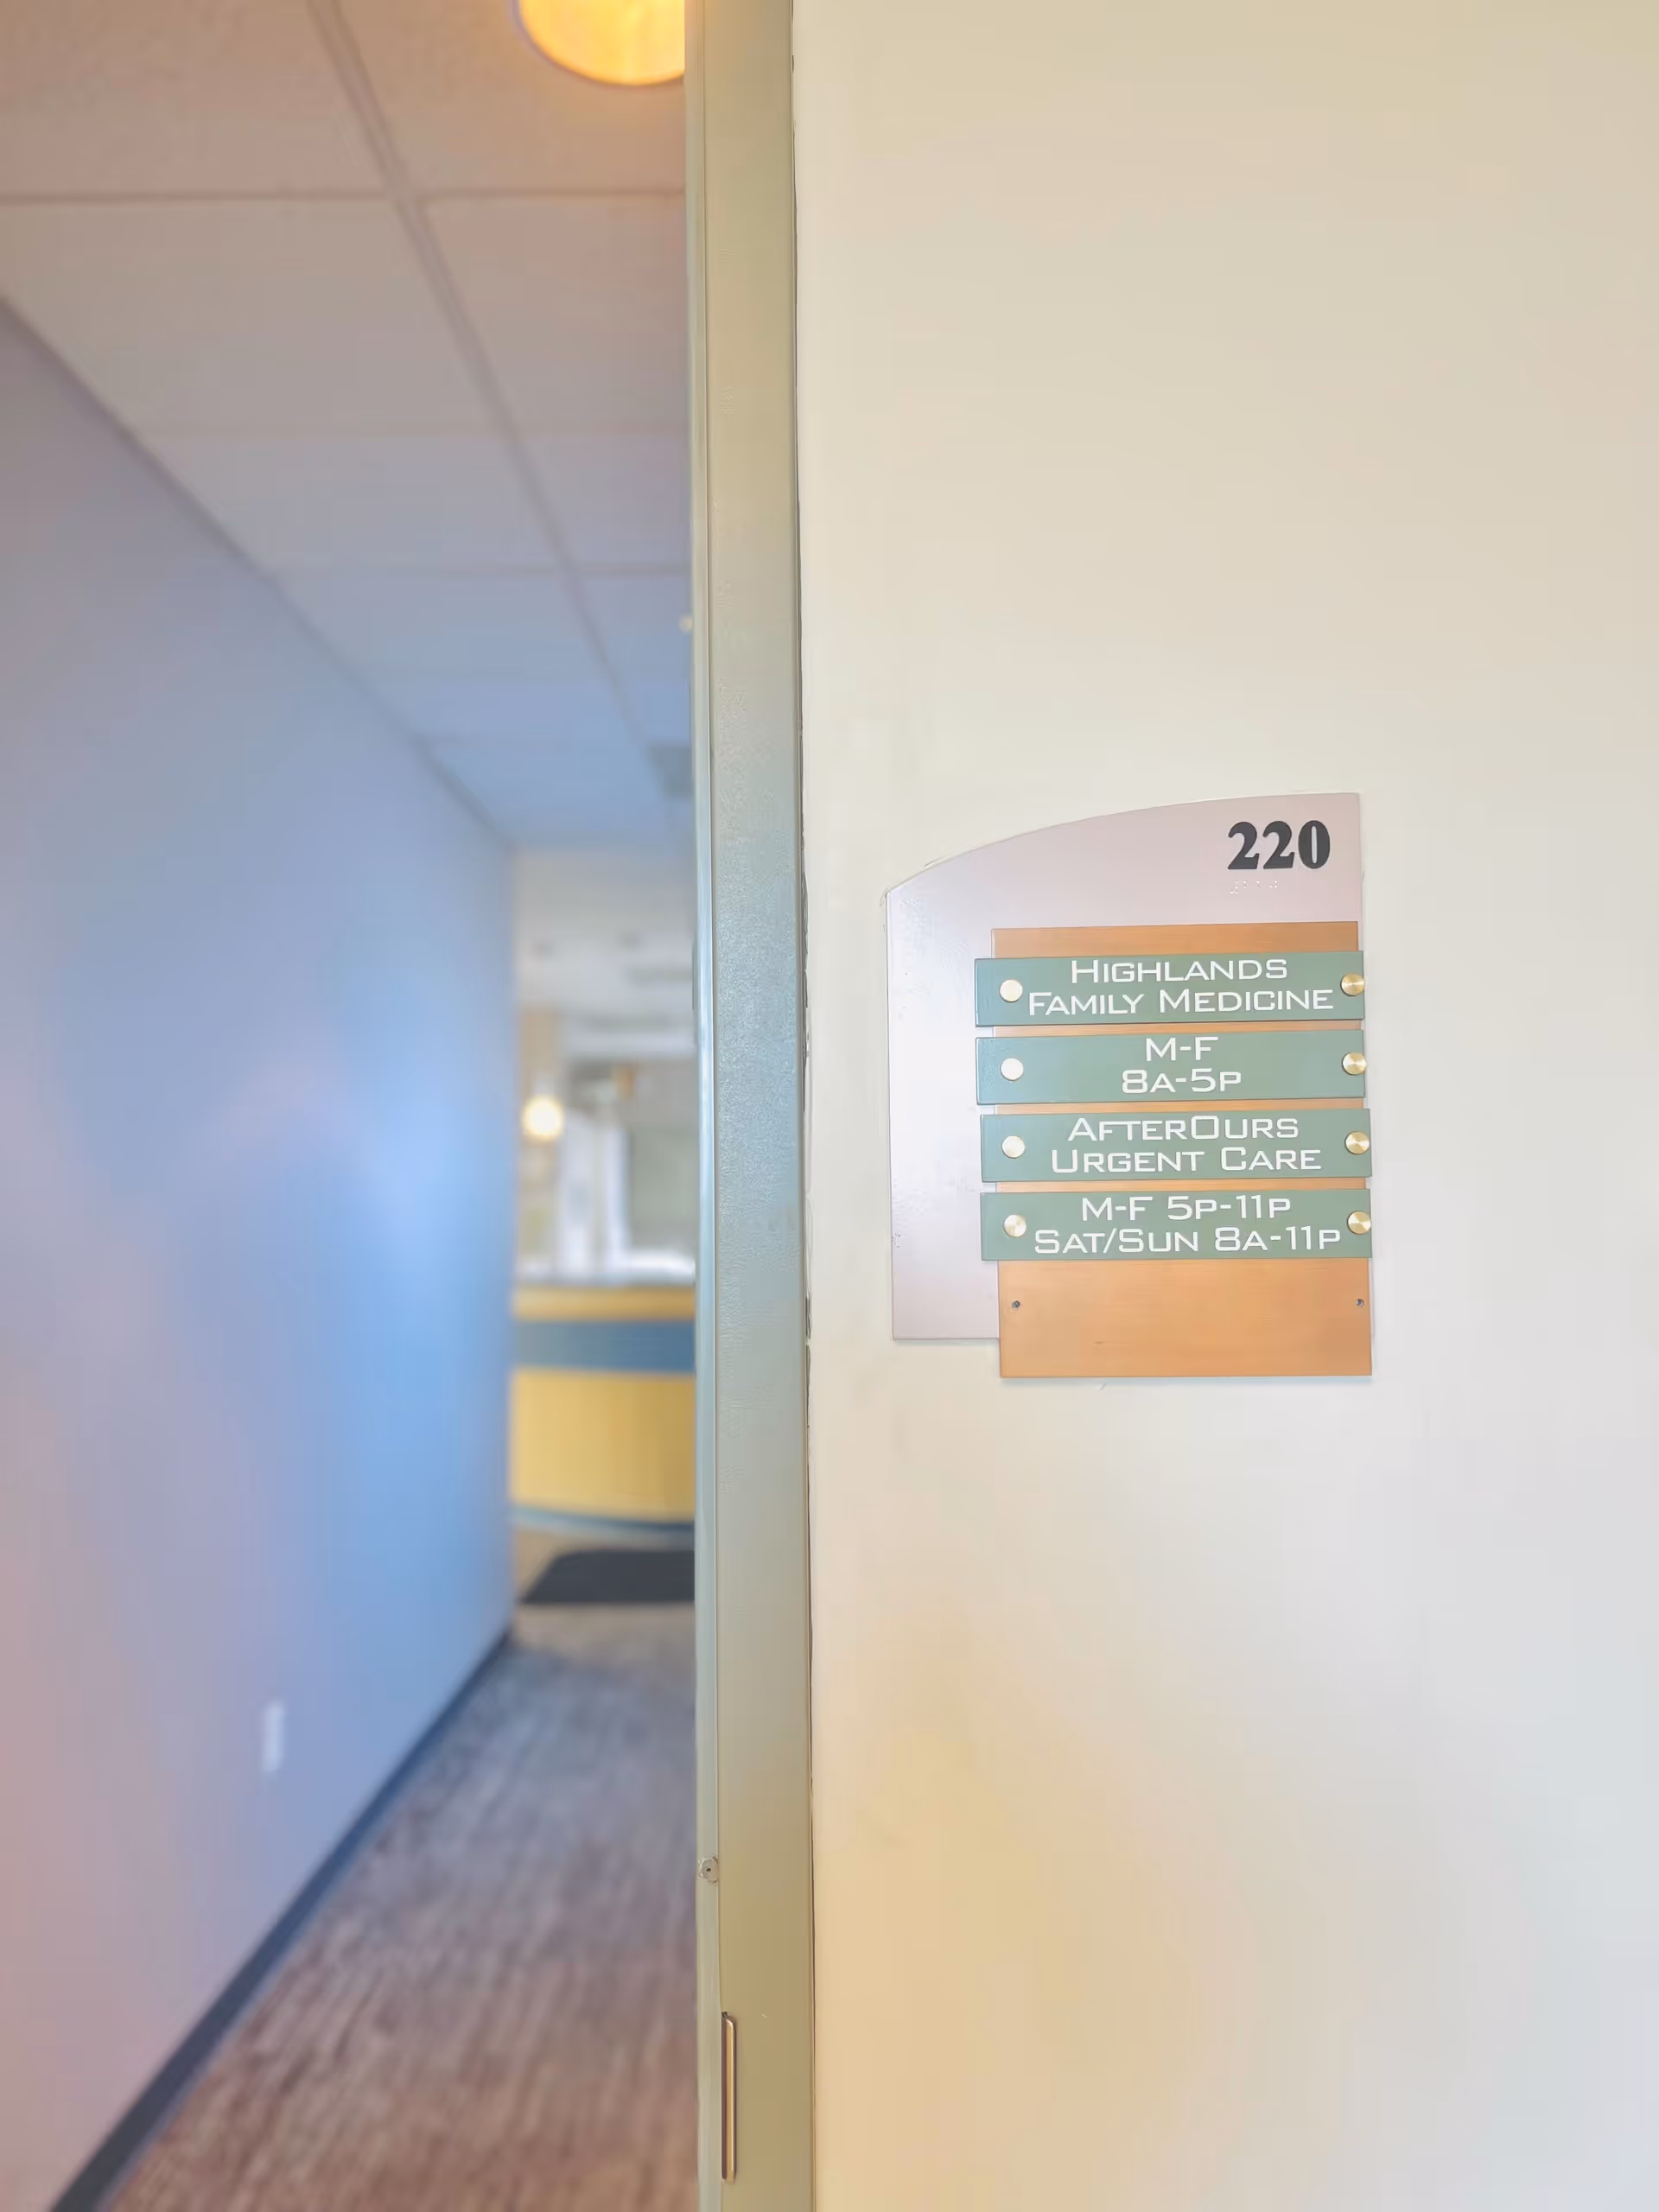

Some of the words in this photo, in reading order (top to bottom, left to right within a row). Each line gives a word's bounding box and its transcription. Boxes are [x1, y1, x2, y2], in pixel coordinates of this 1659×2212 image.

[1227, 820, 1331, 870] 220
[1071, 958, 1287, 983] HIGHLANDS
[1029, 992, 1144, 1016] FAMILY
[1160, 988, 1333, 1013] MEDICINE
[1146, 1036, 1218, 1061] M-F
[1122, 1069, 1242, 1094] 8A-5P
[1068, 1116, 1299, 1141] AFTEROURS
[1052, 1150, 1205, 1173] URGENT
[1221, 1147, 1321, 1171] CARE
[1082, 1197, 1154, 1220] M-F
[1167, 1195, 1291, 1219] 5P-11P
[1034, 1230, 1199, 1254] SAT/SUN
[1215, 1226, 1341, 1251] 8A-11P
